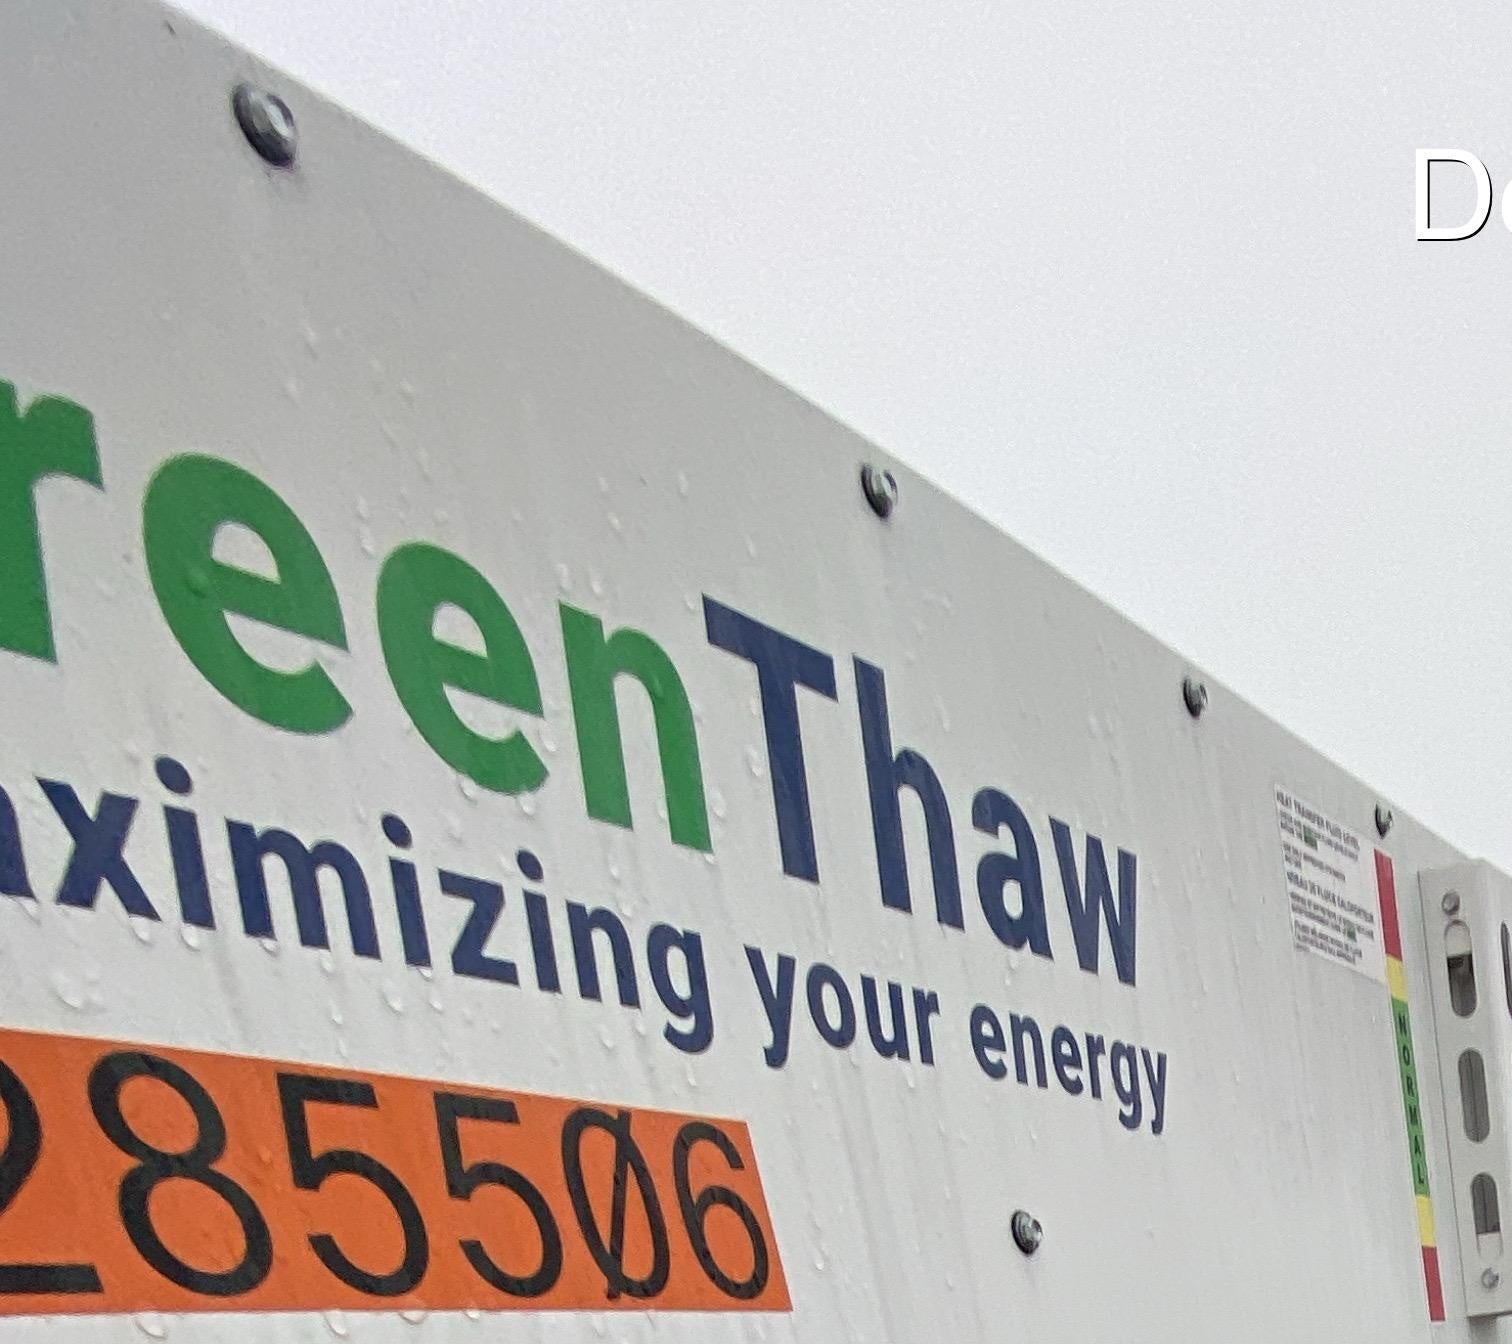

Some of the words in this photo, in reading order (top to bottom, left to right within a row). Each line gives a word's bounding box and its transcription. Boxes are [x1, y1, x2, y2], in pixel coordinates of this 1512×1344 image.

[745, 943, 939, 1070] your
[970, 1002, 1168, 1136] energy
[1399, 1015, 1424, 1184] NORMAL
